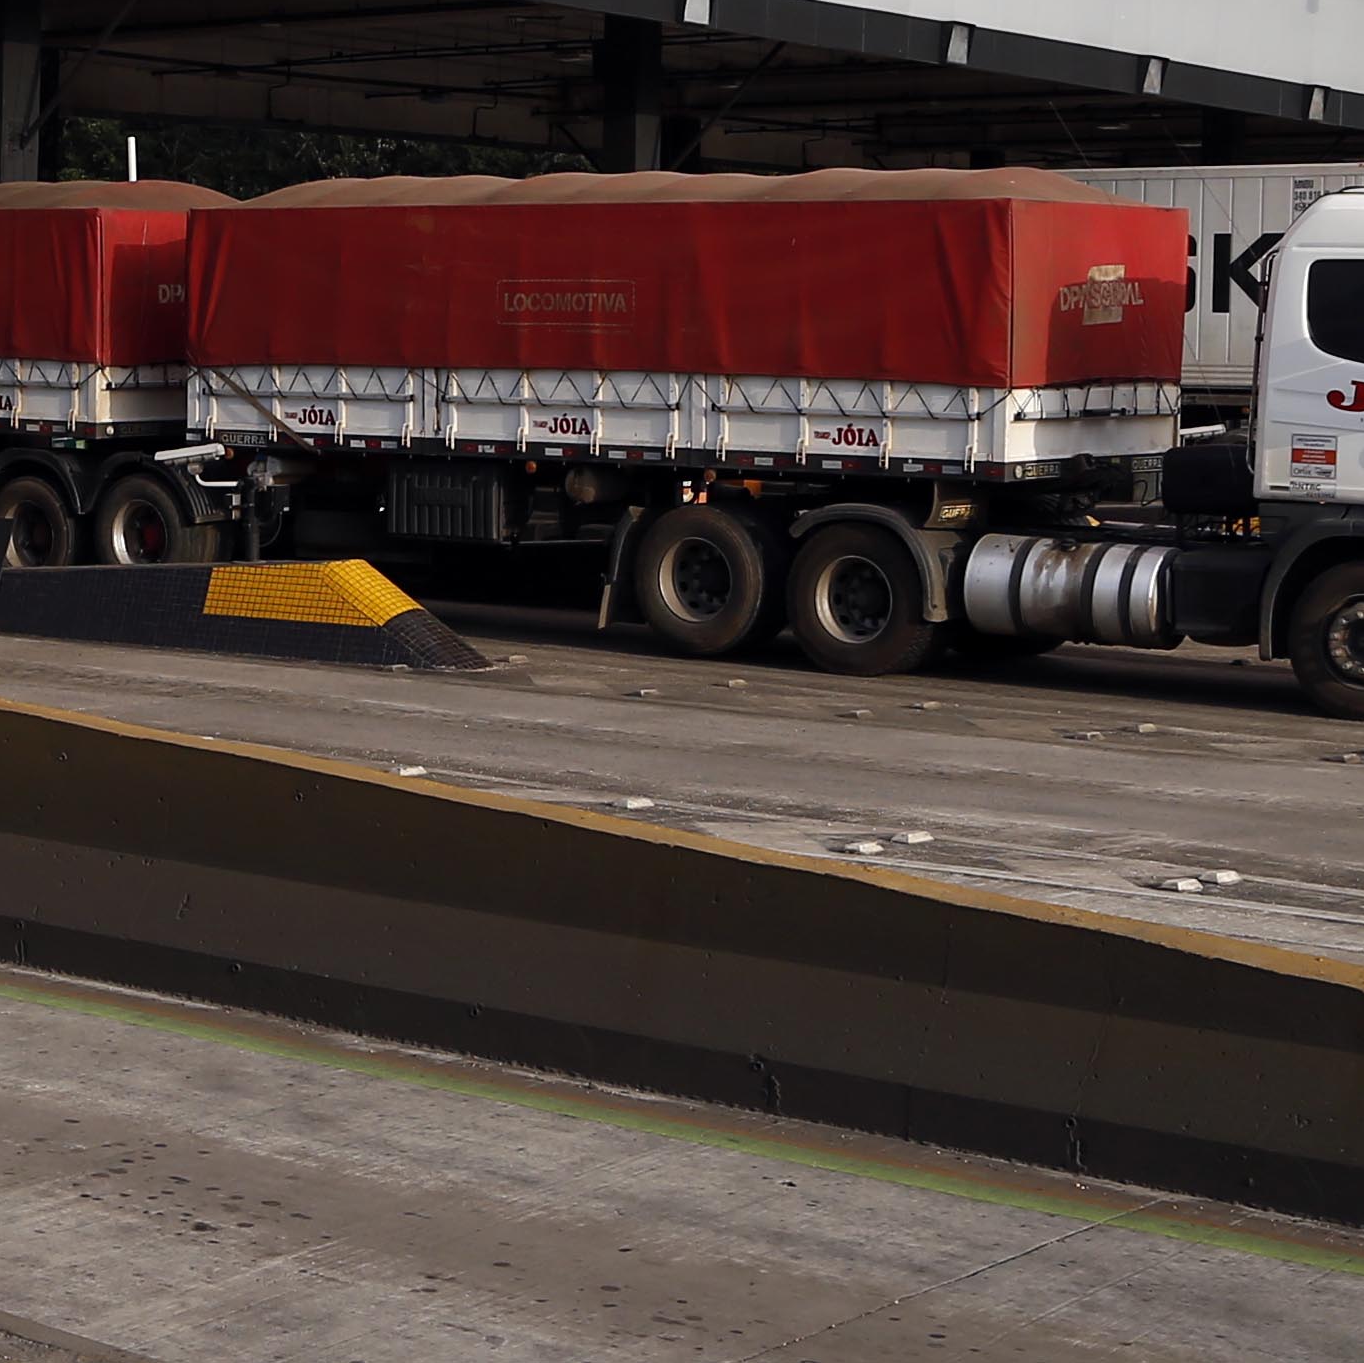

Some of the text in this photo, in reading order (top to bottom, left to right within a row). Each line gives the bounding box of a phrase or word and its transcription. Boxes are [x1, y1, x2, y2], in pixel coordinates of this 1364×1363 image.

[504, 292, 627, 313] LOCOMOTIVA
[298, 404, 336, 426] JÓIA
[548, 412, 591, 435] JÓIA
[220, 433, 267, 445] GUERRA
[831, 423, 879, 447] JÓIA
